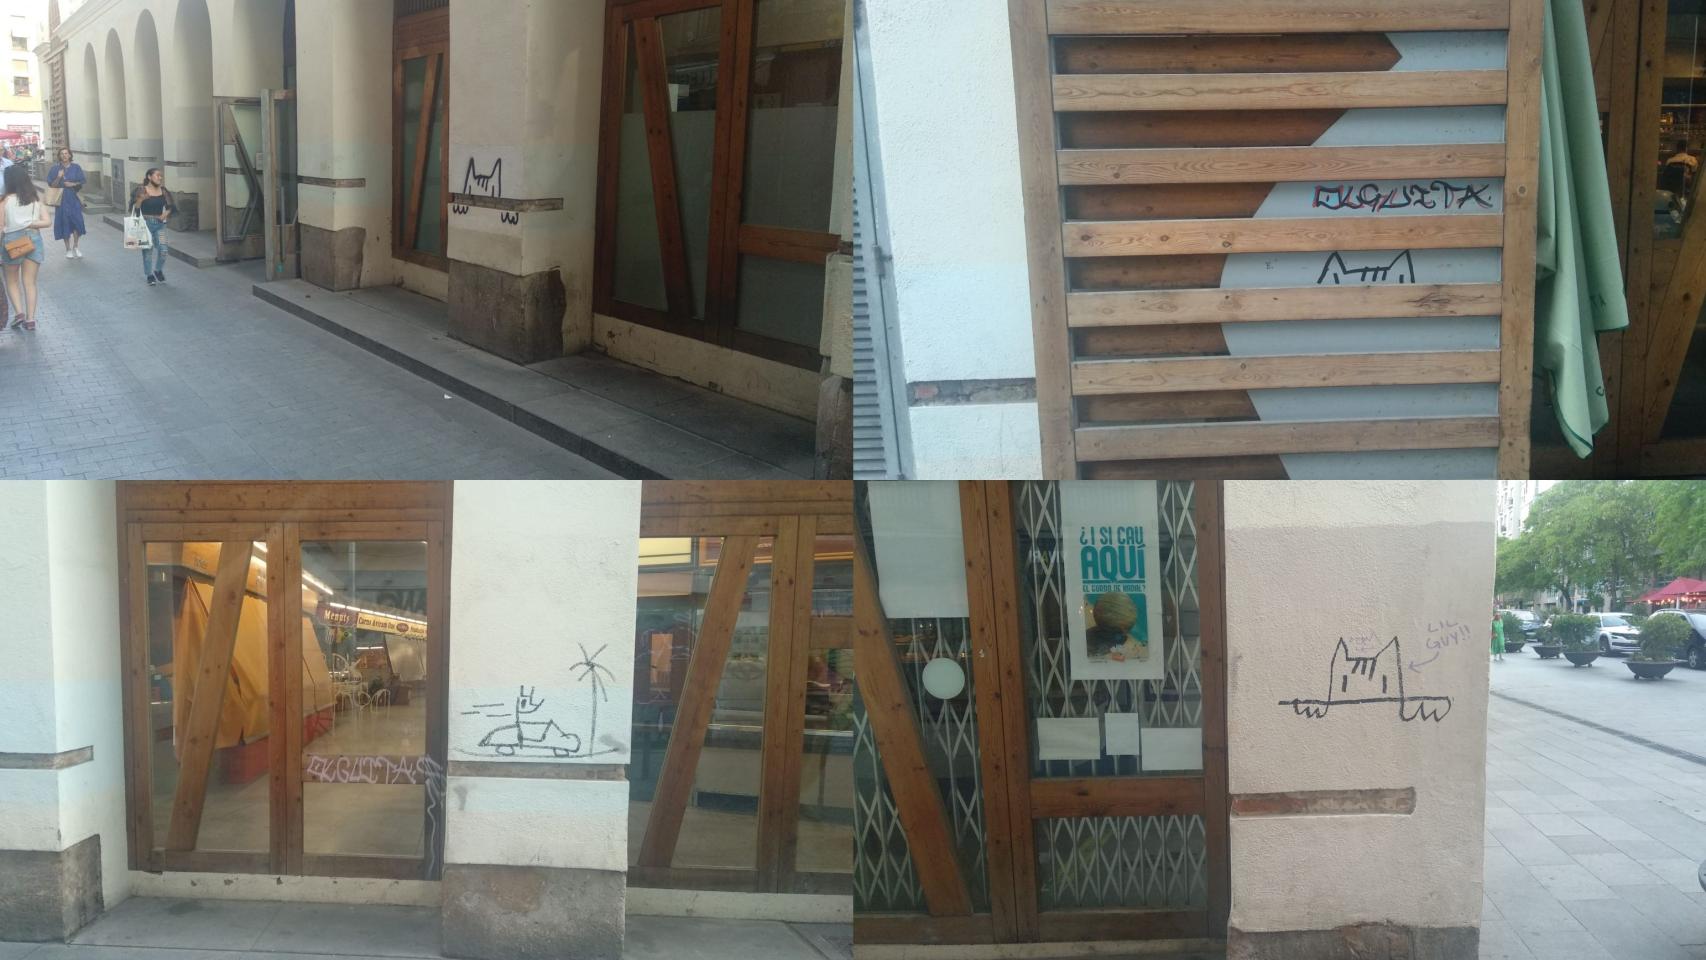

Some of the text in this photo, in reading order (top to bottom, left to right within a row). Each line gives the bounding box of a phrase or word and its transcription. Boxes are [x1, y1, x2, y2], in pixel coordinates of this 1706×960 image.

[1100, 526, 1113, 545] SI
[1117, 526, 1144, 545] CAU
[1080, 544, 1146, 582] AQUÍ
[1083, 584, 1090, 593] EL
[1427, 620, 1458, 633] LIL
[1425, 624, 1471, 650] GUY!!
